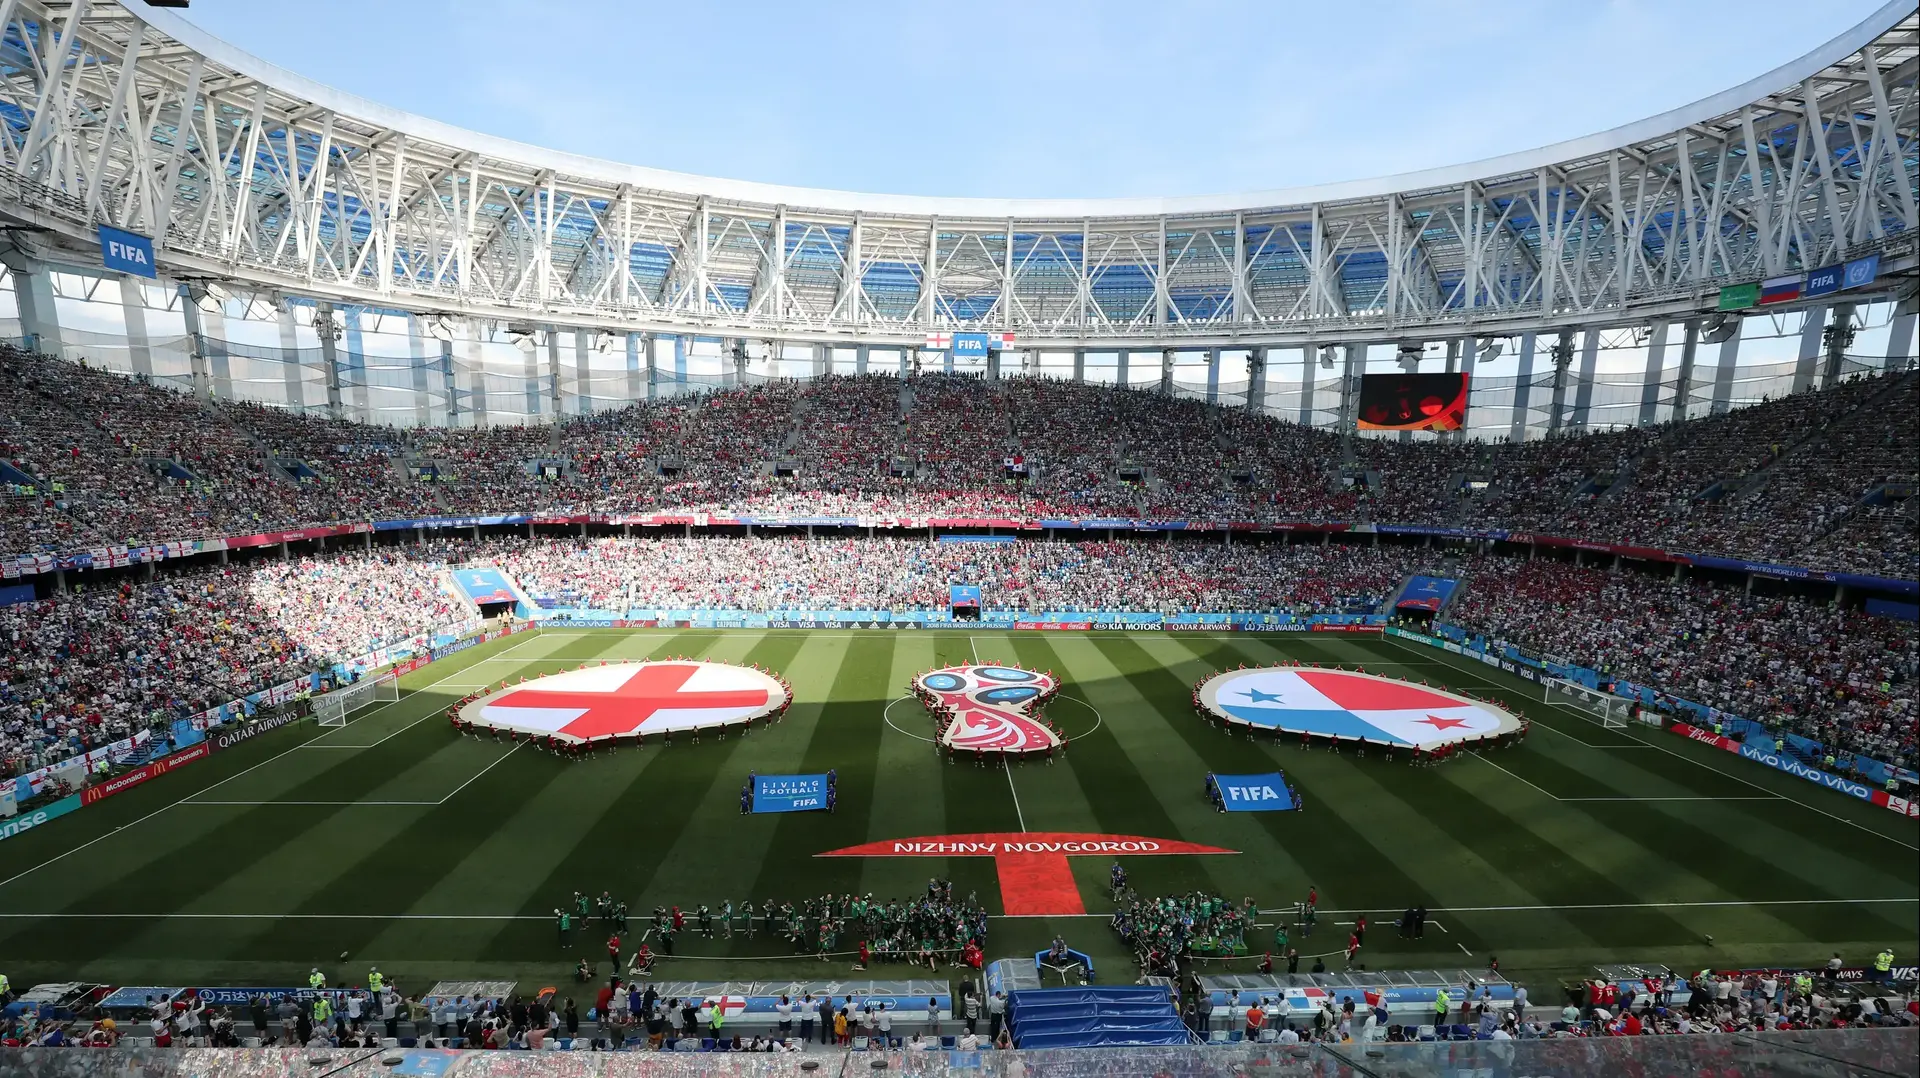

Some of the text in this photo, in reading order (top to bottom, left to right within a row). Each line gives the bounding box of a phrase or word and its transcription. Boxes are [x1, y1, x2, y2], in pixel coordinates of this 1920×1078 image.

[109, 240, 148, 265] FIFA
[1811, 274, 1835, 289] FIFA
[958, 340, 982, 350] FIFA
[1772, 568, 1796, 577] WORLD
[772, 621, 791, 629] VISA
[798, 621, 817, 629] VISA
[823, 621, 842, 629] VISA
[926, 622, 1007, 630] 2018 FIFA WORLD CUP RUSSIA
[1109, 622, 1124, 630] KIA
[1129, 622, 1161, 631] MOTORS
[1172, 624, 1231, 632] QATAR AIRWAYS
[1275, 624, 1306, 632] WANDA
[1397, 629, 1432, 645] Hisense
[454, 638, 477, 655] WANDA
[1501, 660, 1515, 674] VISA
[1520, 668, 1534, 681] VISA
[218, 709, 298, 748] QATAR AIRWAYS
[1688, 726, 1720, 748] Bud
[106, 747, 204, 793] McDonald's McDonald's
[762, 780, 819, 789] LIVING
[762, 786, 819, 795] FOOTBALL
[1228, 785, 1279, 801] FIFA
[793, 798, 818, 808] FIFA
[893, 841, 1160, 854] NIZHNY NOVGOROD
[217, 991, 247, 1003] 万达
